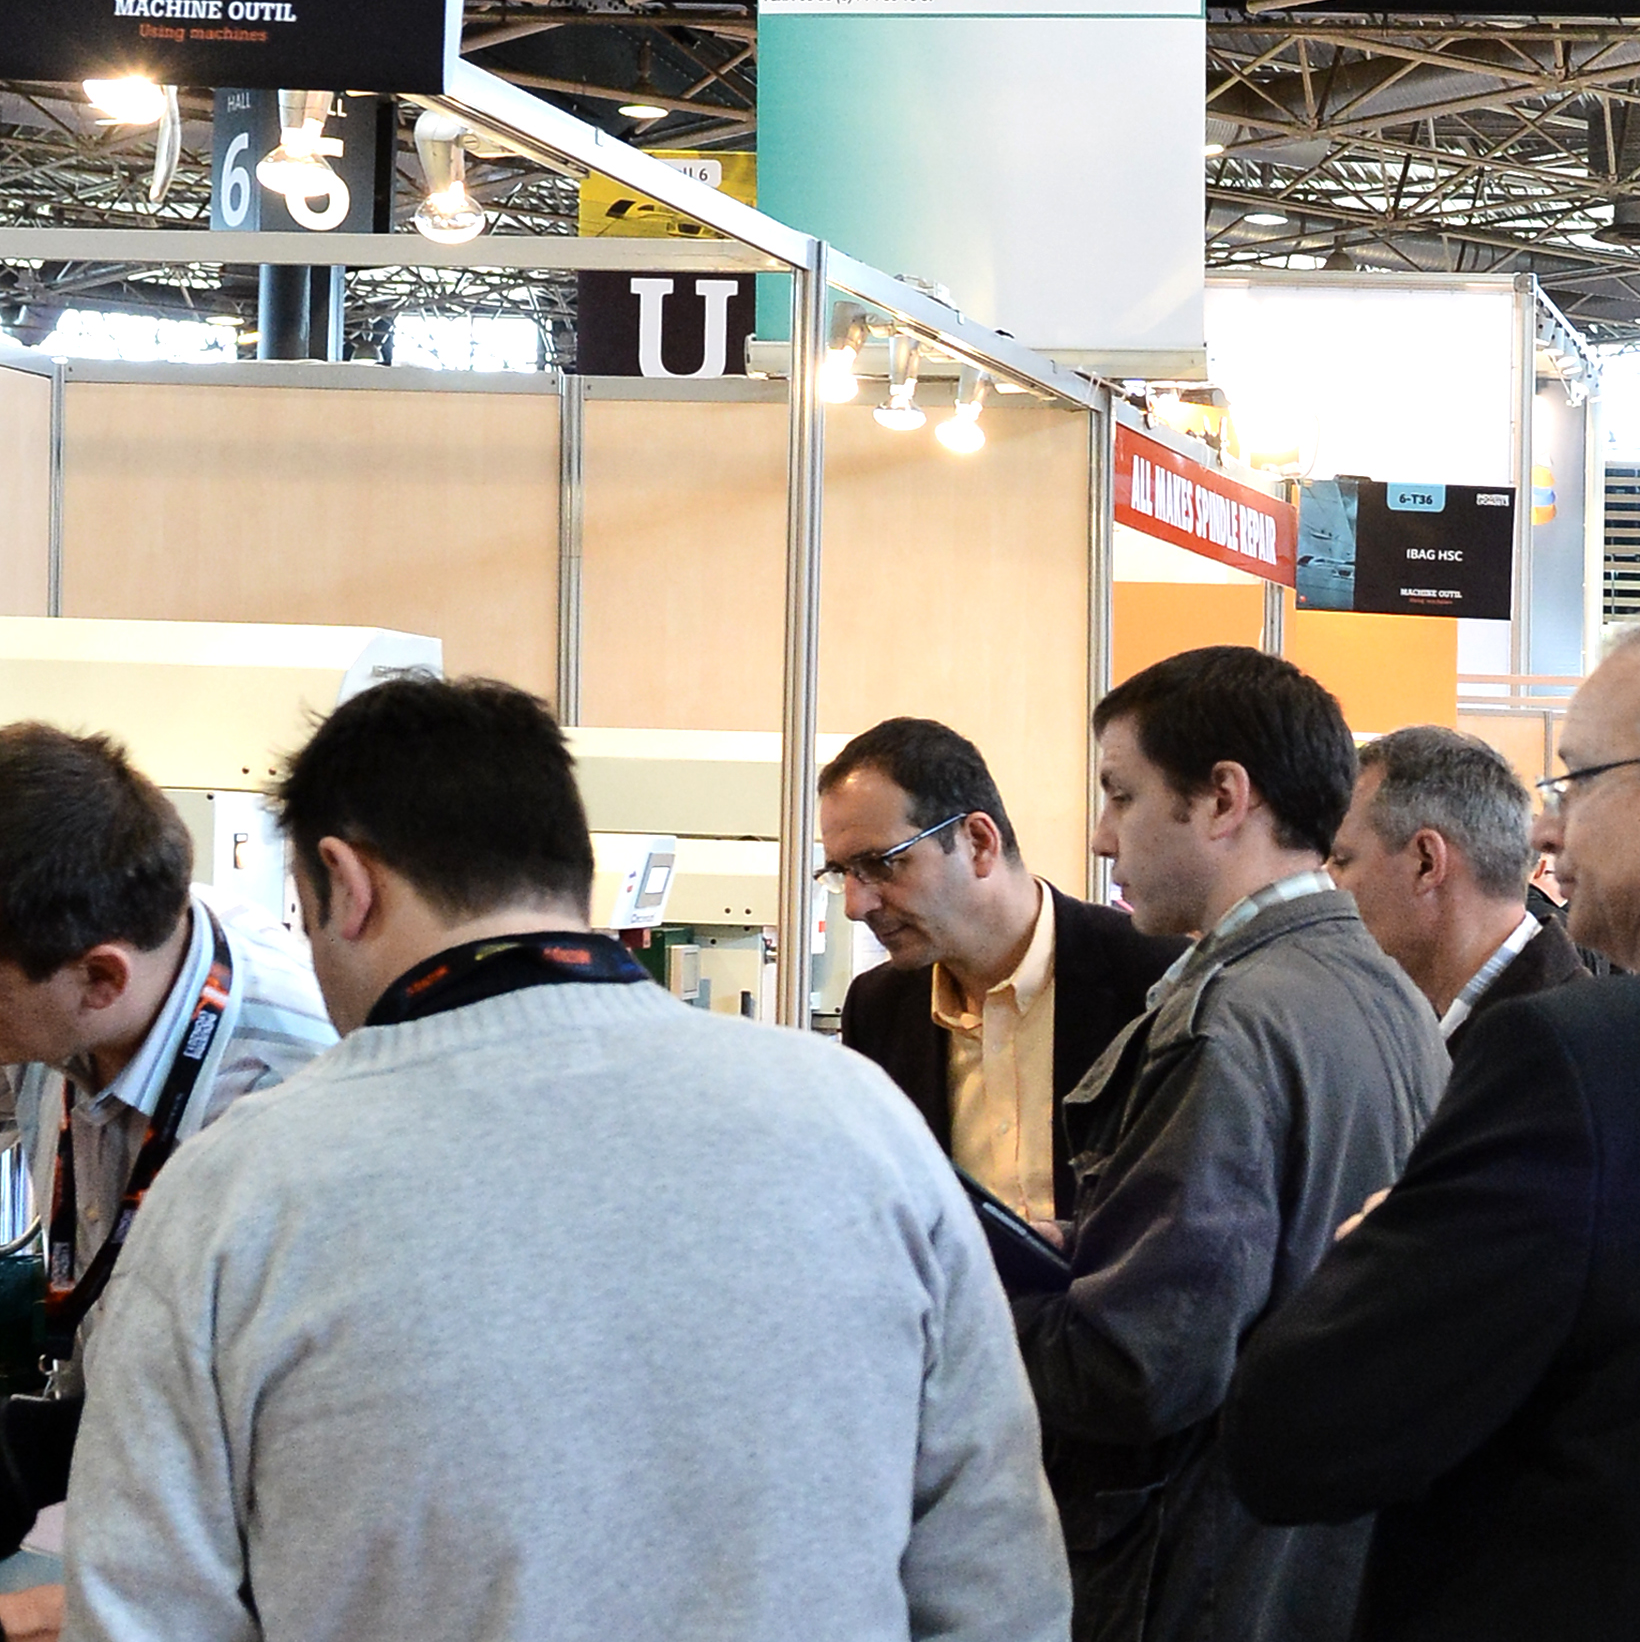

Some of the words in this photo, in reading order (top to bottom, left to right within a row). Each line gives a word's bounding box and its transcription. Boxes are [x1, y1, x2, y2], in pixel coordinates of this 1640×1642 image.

[228, 1, 297, 22] OUTIL
[139, 23, 185, 41] Using
[190, 27, 268, 41] machines
[220, 132, 250, 227] 6
[631, 278, 738, 377] U
[1399, 492, 1433, 506] 6-T36
[1131, 455, 1153, 516] ALL
[1155, 465, 1194, 534] MAKES
[1196, 485, 1238, 551] SPINDLE
[1240, 505, 1276, 565] REPAIR
[1407, 549, 1435, 560] IBAG
[1438, 550, 1463, 561] HSC
